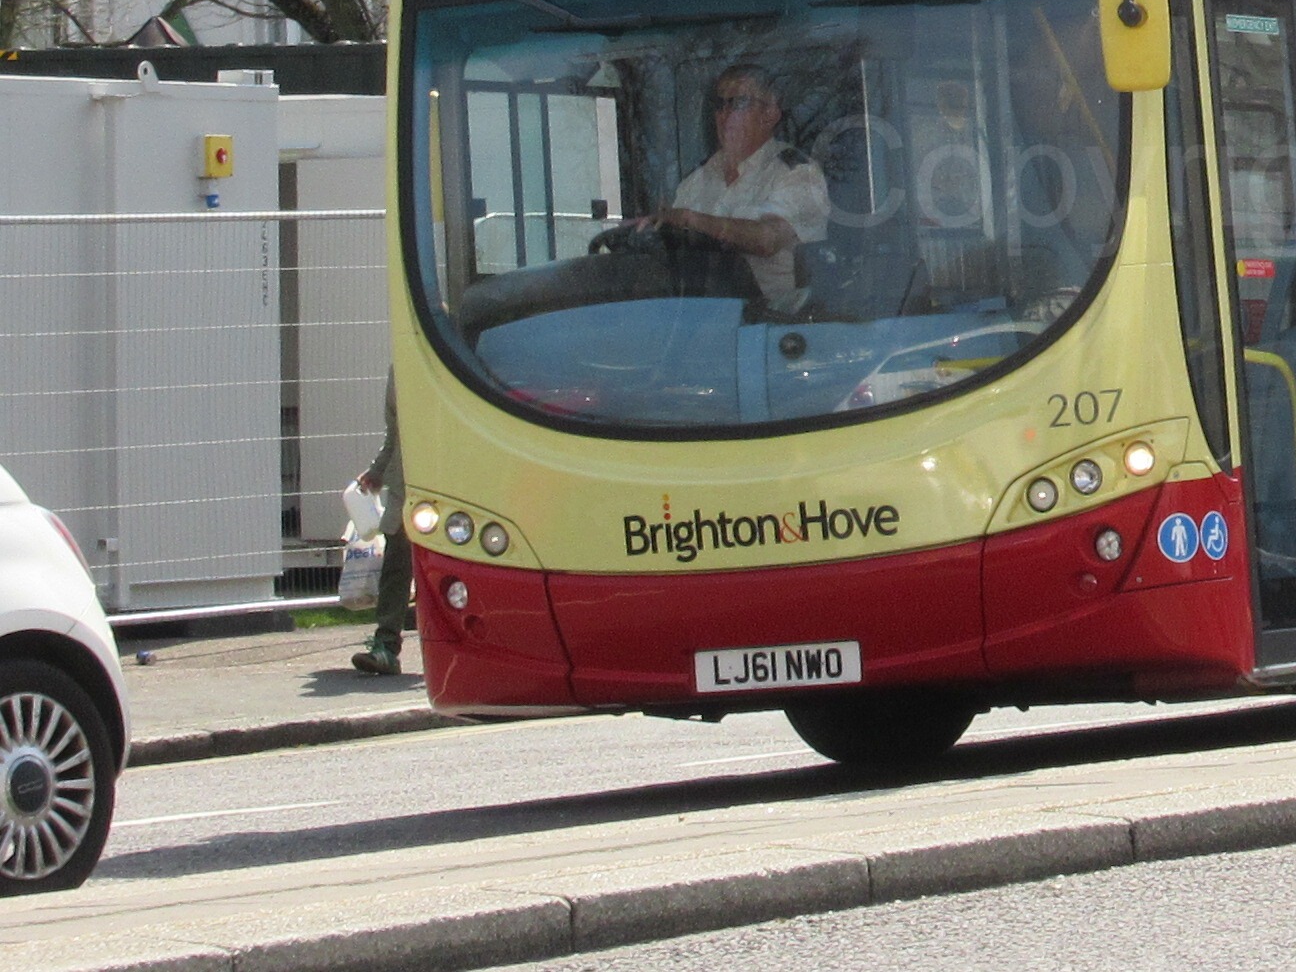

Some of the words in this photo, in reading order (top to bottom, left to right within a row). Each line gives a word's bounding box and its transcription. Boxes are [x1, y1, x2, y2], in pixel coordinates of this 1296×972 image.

[1047, 388, 1123, 428] 207
[713, 652, 777, 686] LJ61
[785, 647, 843, 681] NWO
